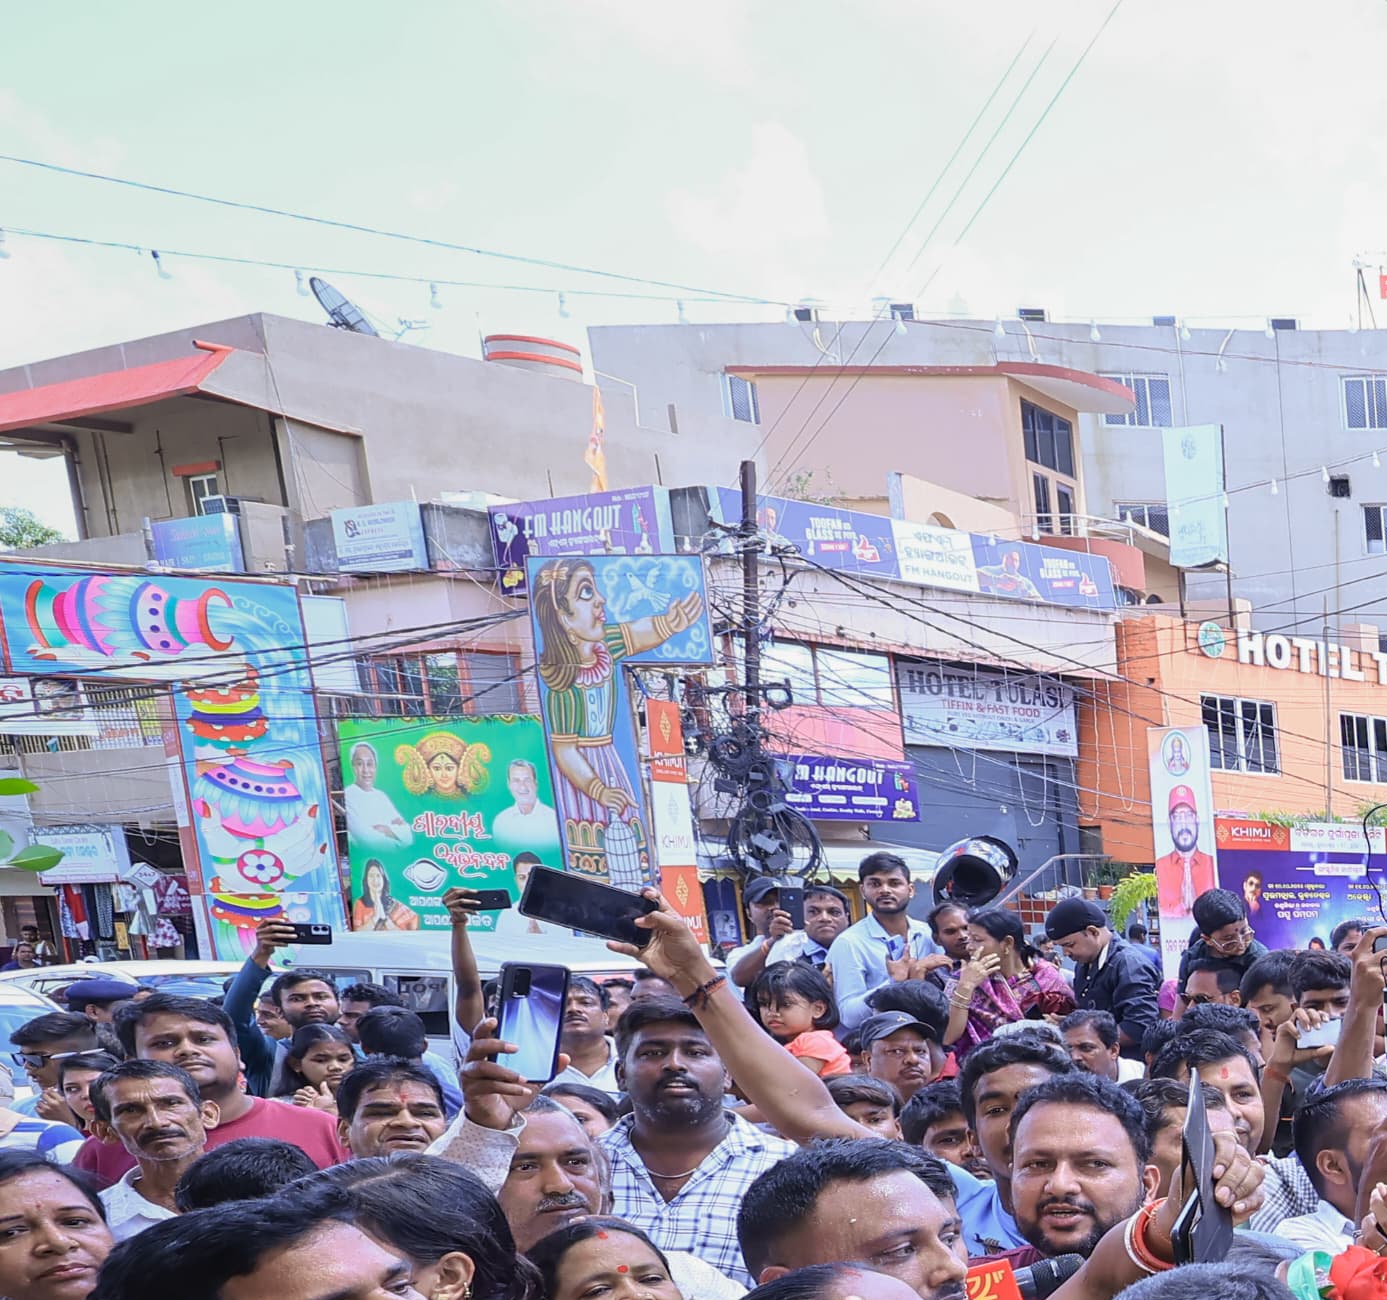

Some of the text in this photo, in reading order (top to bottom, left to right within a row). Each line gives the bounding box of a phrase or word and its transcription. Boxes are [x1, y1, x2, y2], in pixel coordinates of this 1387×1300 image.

[523, 505, 621, 539] FM HANGOUT
[1237, 629, 1365, 681] HOTEL
[906, 669, 1066, 708] HOTEL TULASI
[942, 699, 1040, 718] TIFFIN & FAST FOOD
[812, 766, 885, 785] HANGOUT
[1231, 826, 1271, 838] KHIMJI
